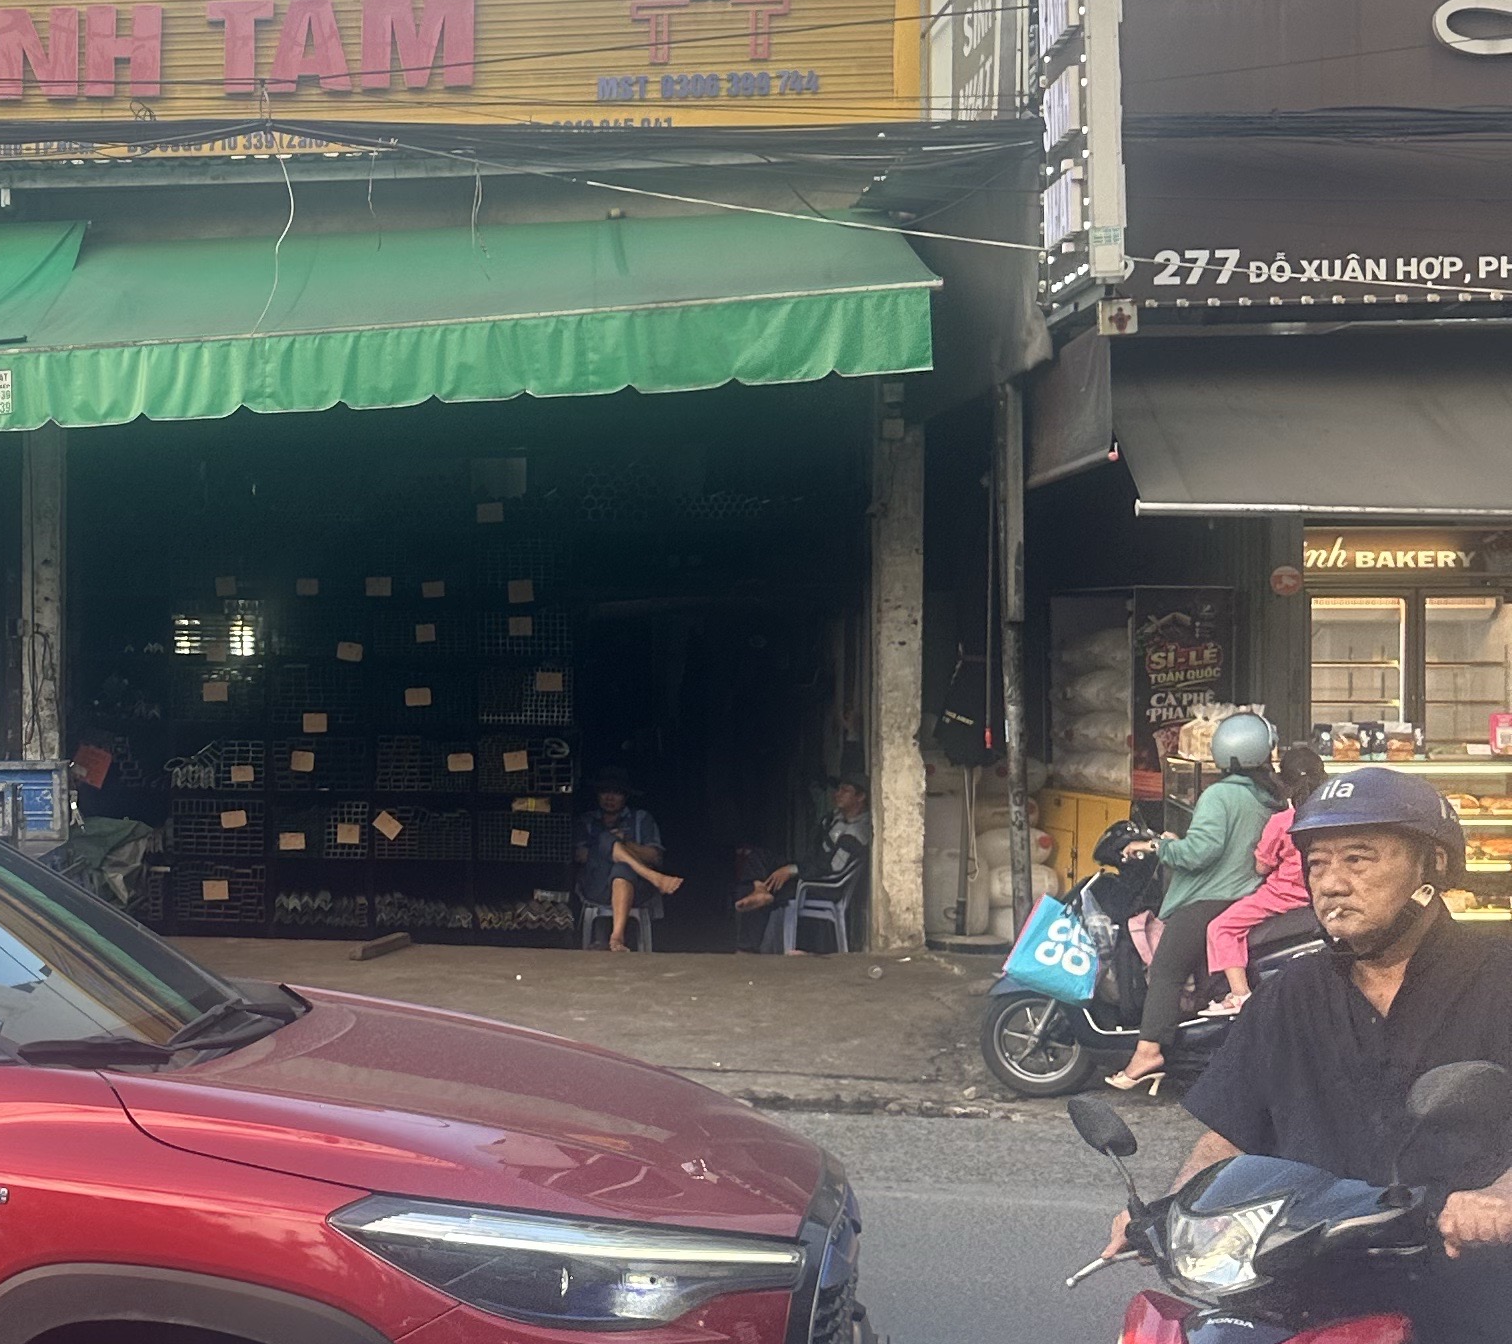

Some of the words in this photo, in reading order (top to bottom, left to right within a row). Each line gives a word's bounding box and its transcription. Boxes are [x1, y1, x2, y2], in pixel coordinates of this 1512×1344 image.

[597, 76, 649, 101] MST
[777, 70, 820, 94] 744
[242, 133, 273, 151] 339
[1153, 249, 1240, 285] 277
[1248, 253, 1292, 284] ĐỖ
[1300, 253, 1388, 283] XUÂN
[1355, 551, 1476, 568] BAKERY
[1320, 779, 1355, 801] ila
